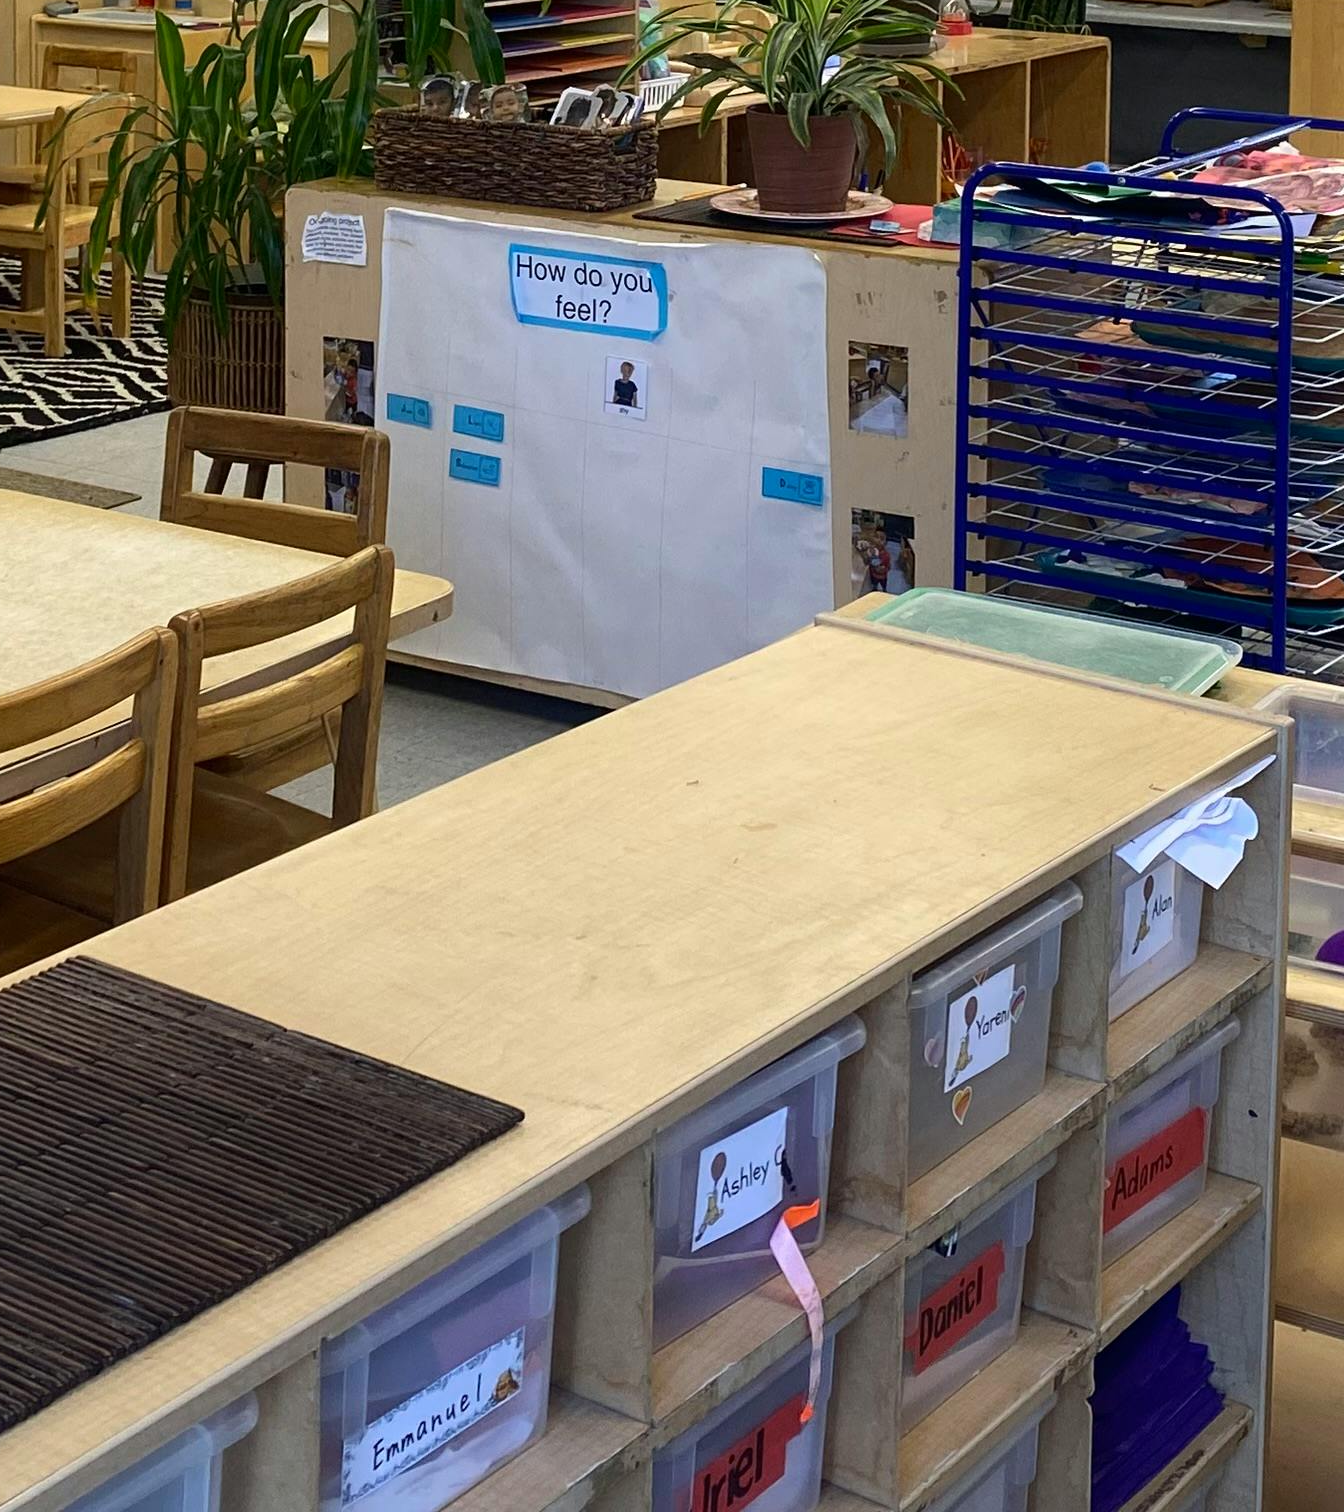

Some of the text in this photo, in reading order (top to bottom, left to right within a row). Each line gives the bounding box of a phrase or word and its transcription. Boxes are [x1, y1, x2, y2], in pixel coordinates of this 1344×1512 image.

[516, 254, 653, 295] How do you
[556, 295, 612, 323] feel?
[1152, 894, 1172, 920] Alan
[720, 1160, 770, 1203] Ashley
[1112, 1145, 1174, 1211] Adams
[919, 1265, 983, 1357] Daniel
[373, 1373, 482, 1471] Emmanuel
